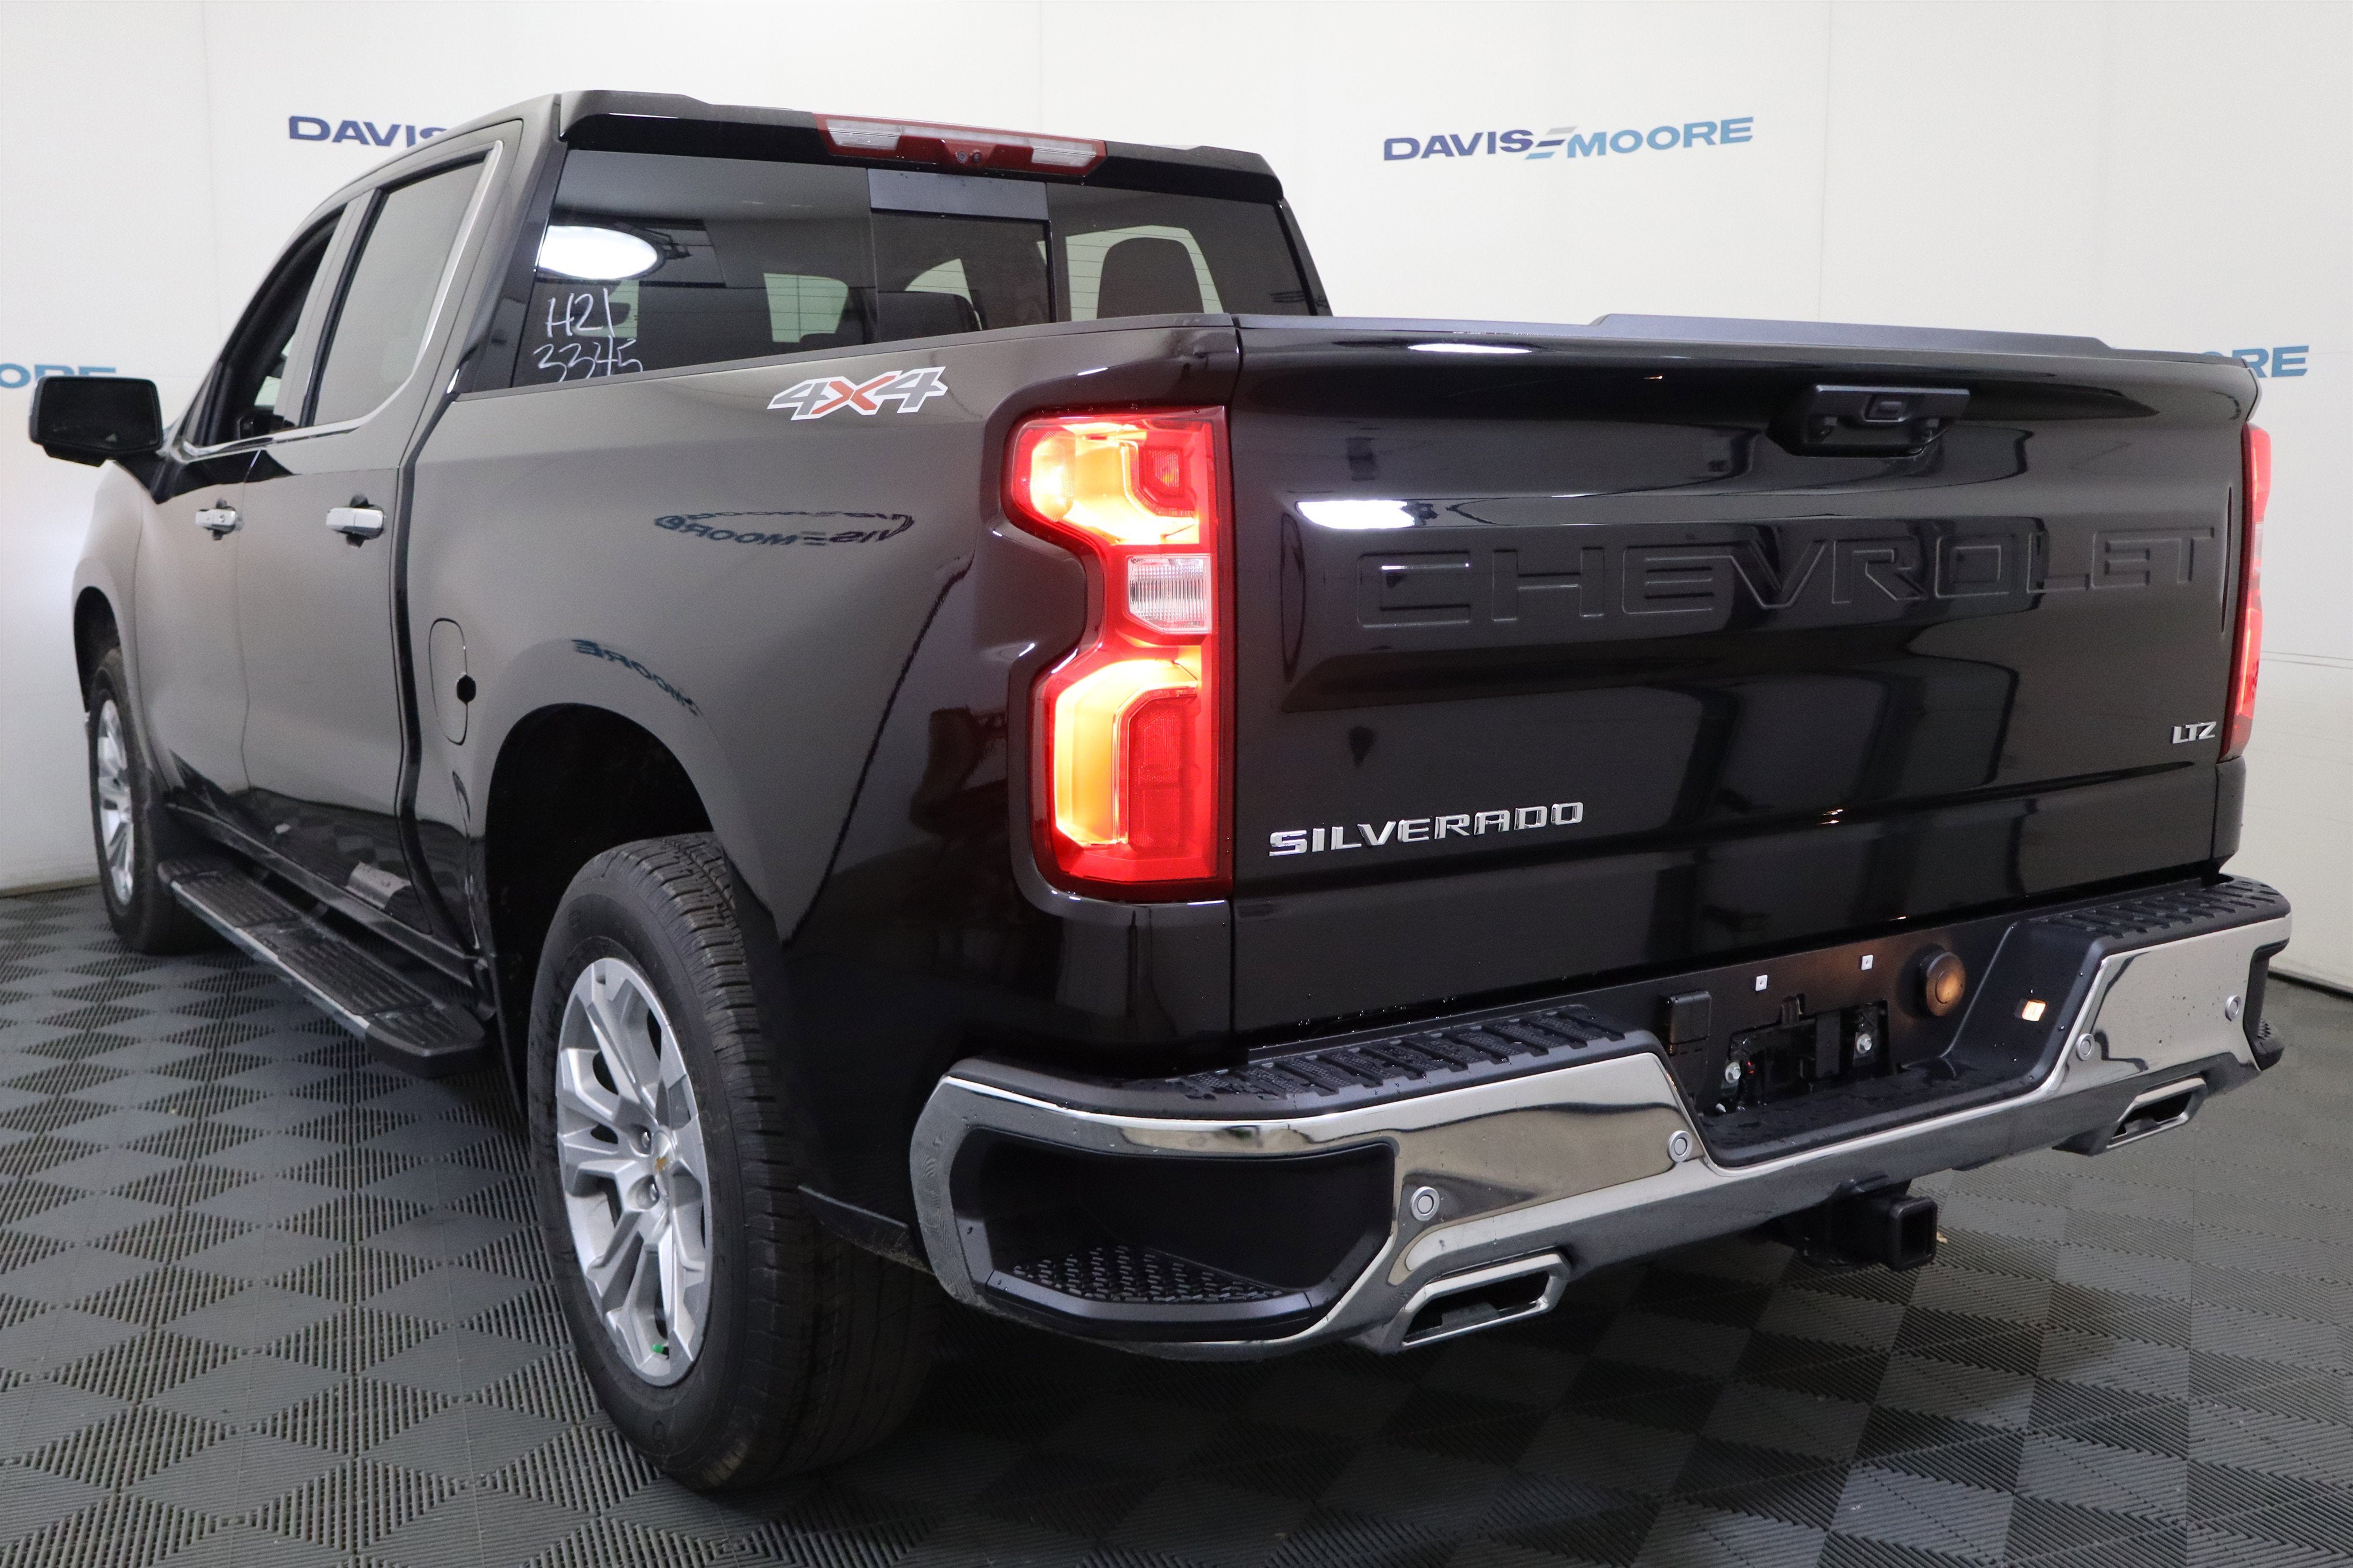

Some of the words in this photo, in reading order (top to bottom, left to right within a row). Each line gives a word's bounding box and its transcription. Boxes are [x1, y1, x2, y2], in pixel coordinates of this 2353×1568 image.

[1357, 525, 2215, 629] CHEVROLET
[2172, 721, 2217, 744] LTZ
[1268, 802, 1584, 856] SILVERADO
